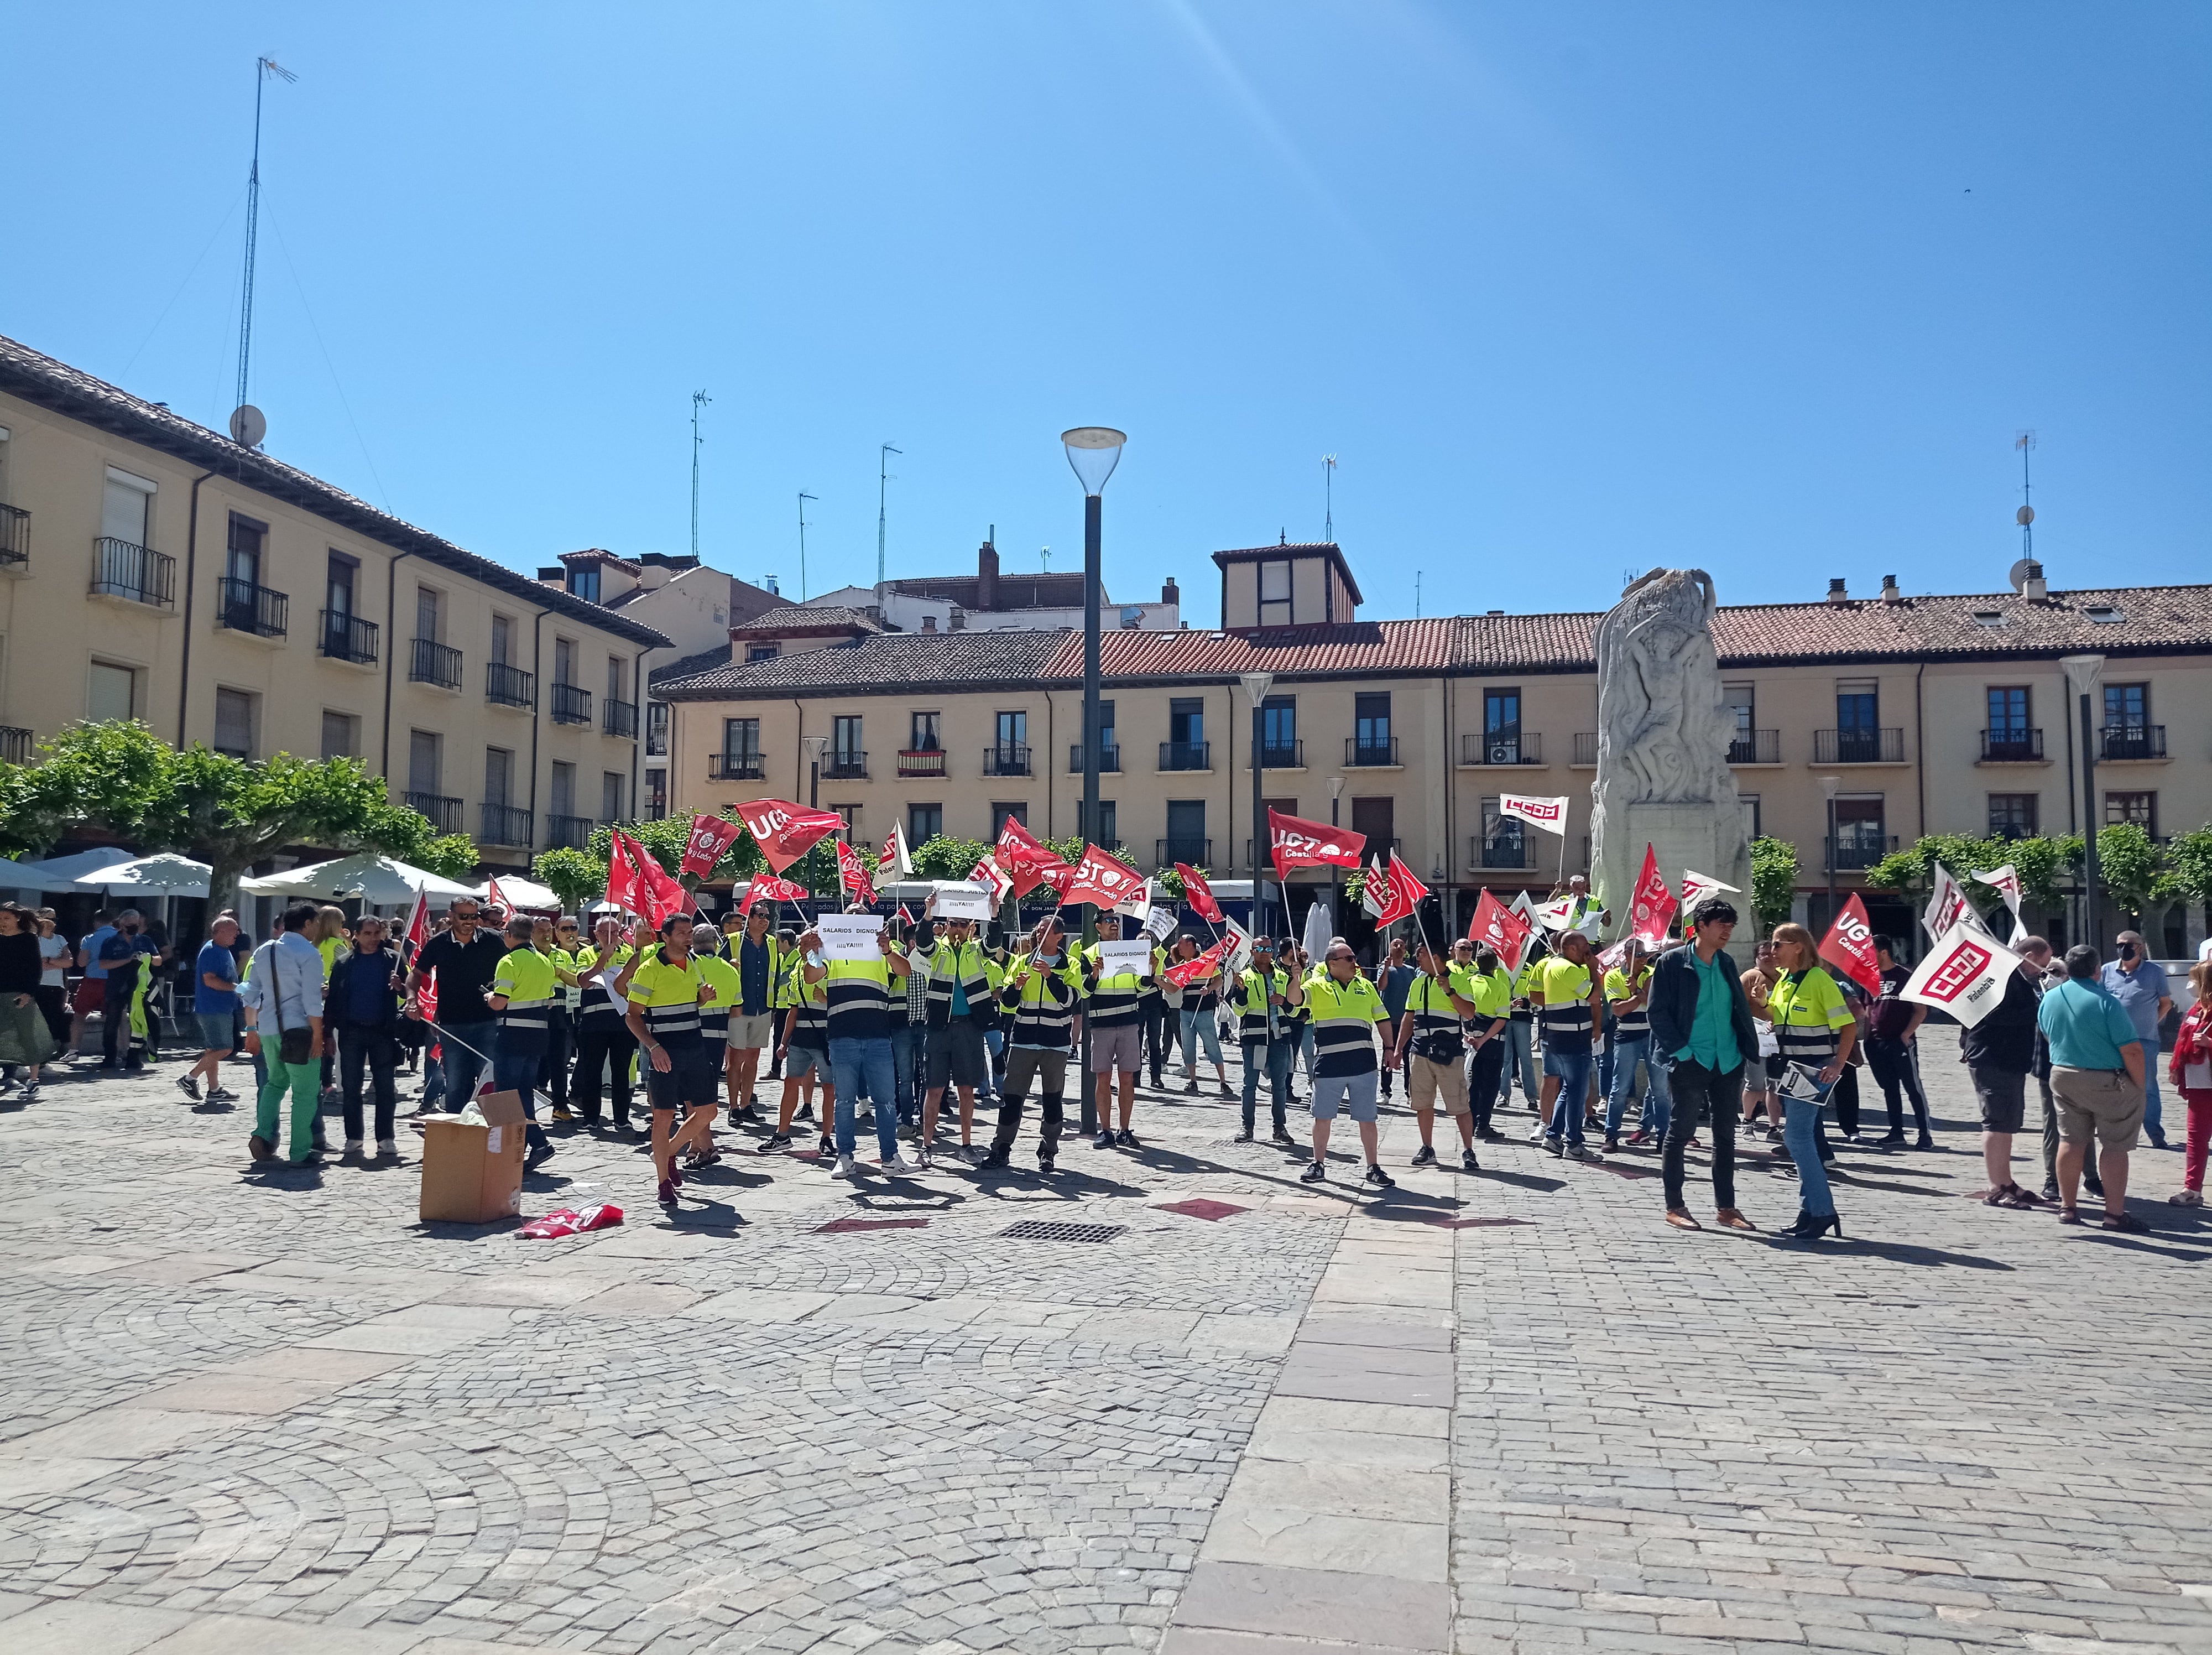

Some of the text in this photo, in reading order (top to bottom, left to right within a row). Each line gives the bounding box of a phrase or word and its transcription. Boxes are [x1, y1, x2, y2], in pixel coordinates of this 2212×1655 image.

[1271, 827, 1322, 852] UGT
[1285, 848, 1321, 858] Castilla
[1075, 858, 1105, 882] GT
[878, 902, 885, 910] la
[1838, 936, 1867, 961] Castilla
[1927, 946, 1985, 997] CCOO
